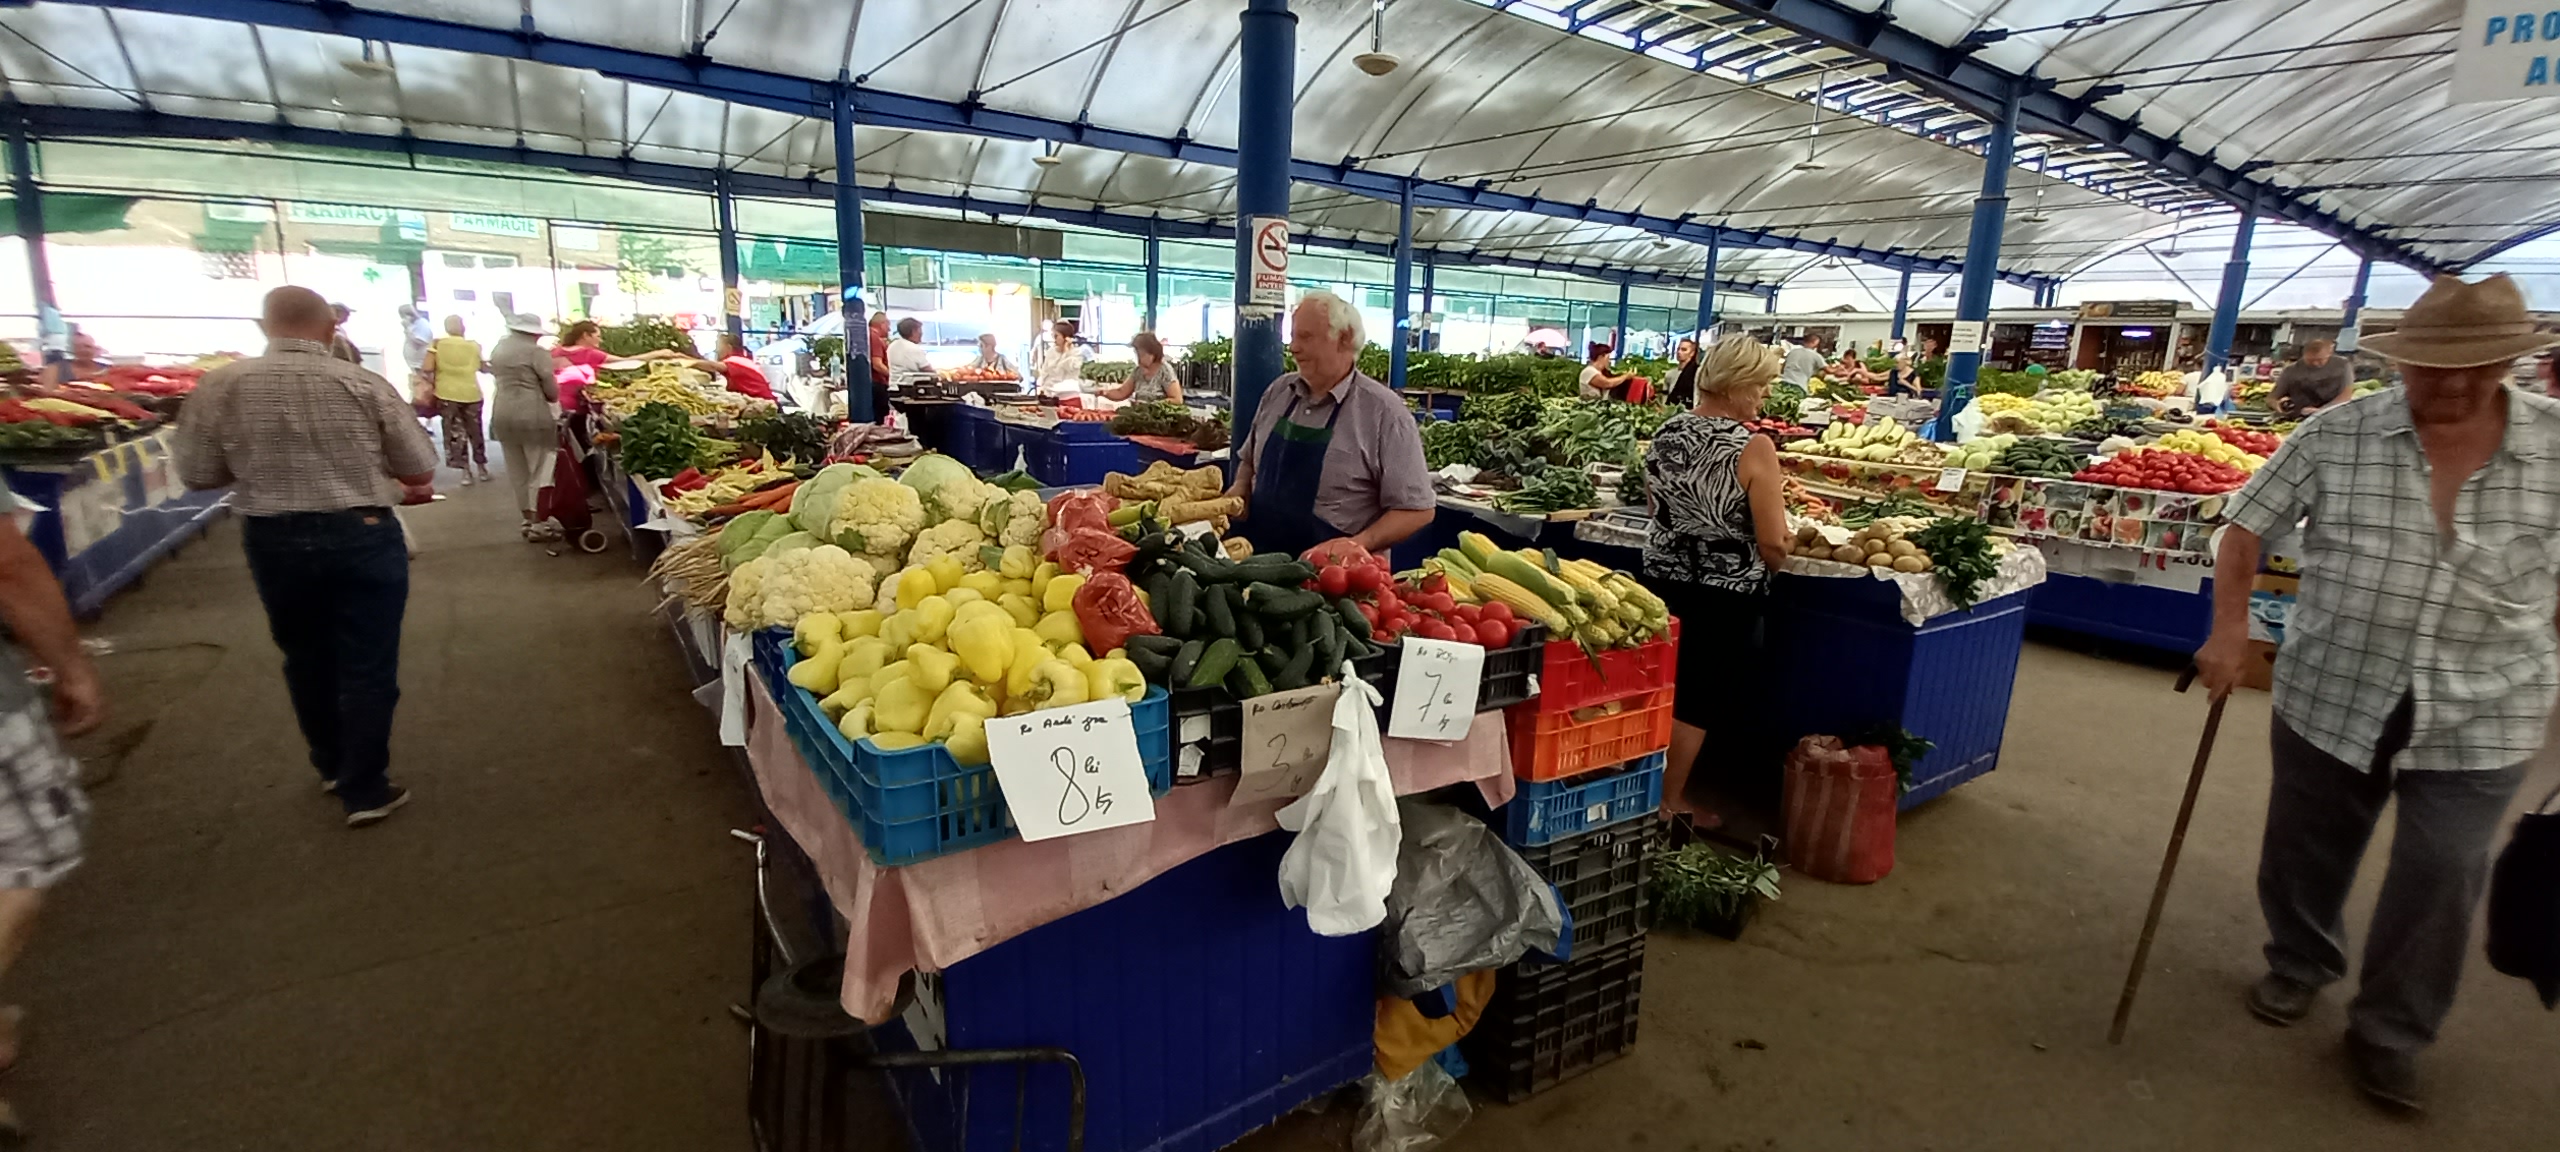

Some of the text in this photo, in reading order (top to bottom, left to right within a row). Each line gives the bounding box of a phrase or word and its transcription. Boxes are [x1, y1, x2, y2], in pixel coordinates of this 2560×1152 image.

[1418, 671, 1443, 723] 7
[1050, 746, 1090, 826] 8
[1084, 756, 1101, 774] lei
[1254, 733, 1291, 792] 3
